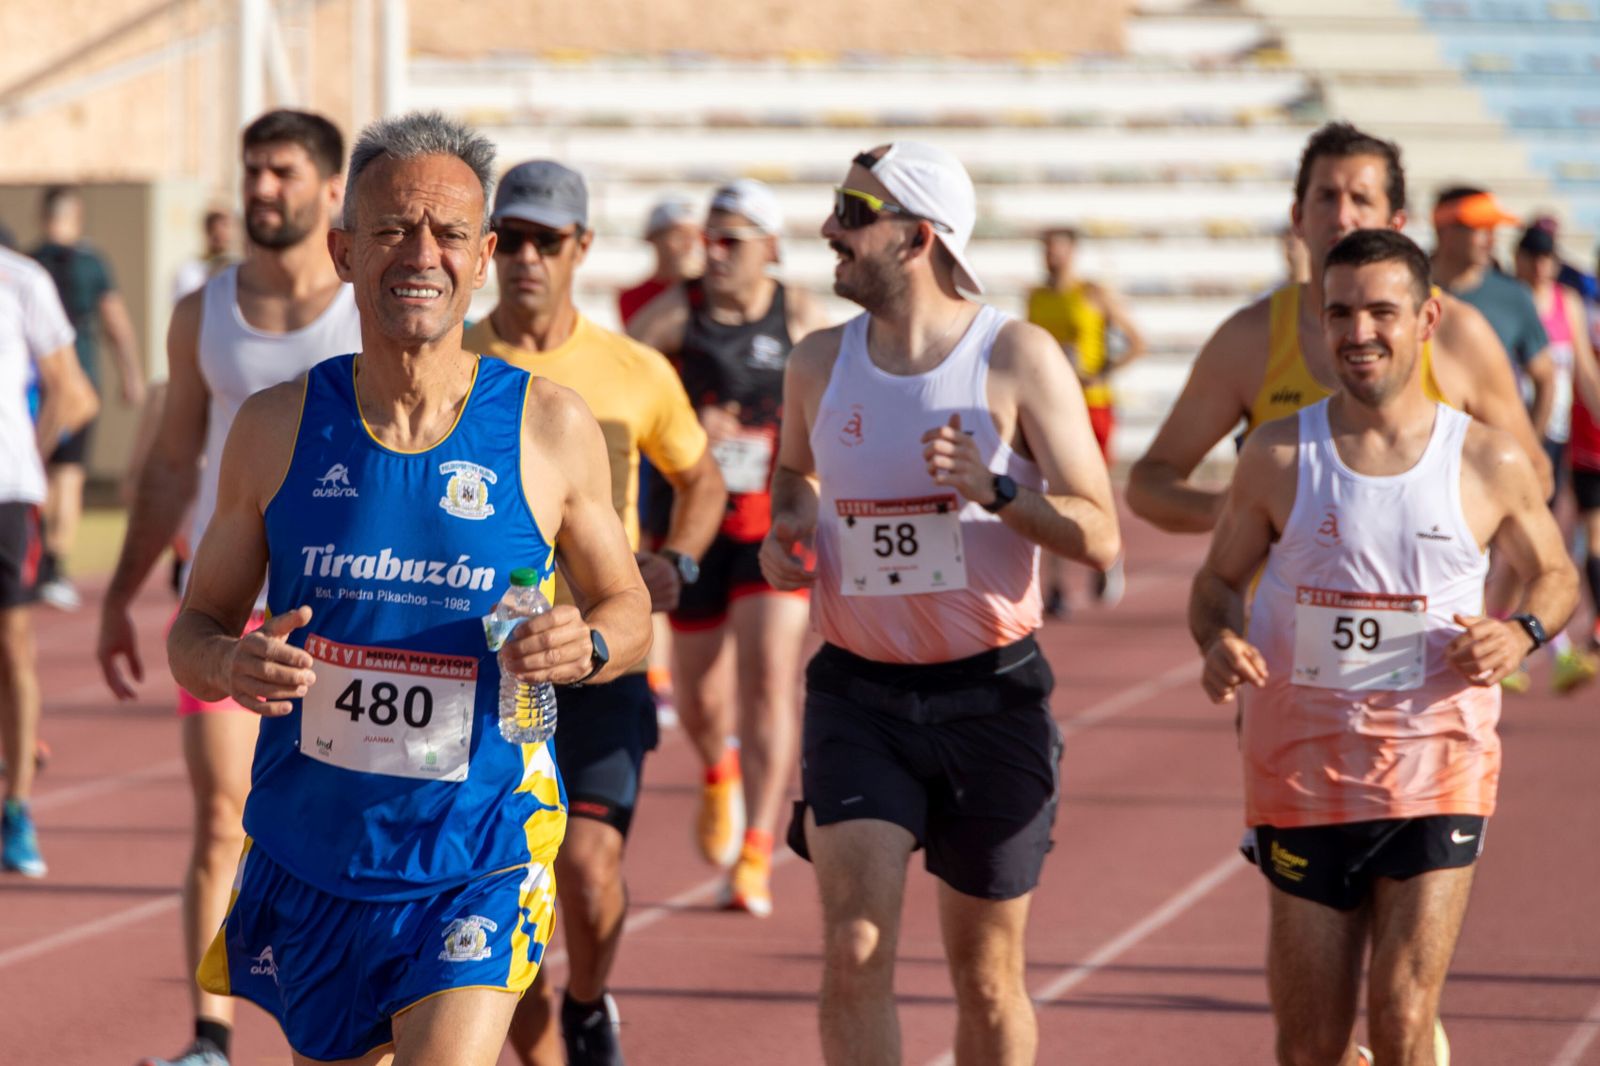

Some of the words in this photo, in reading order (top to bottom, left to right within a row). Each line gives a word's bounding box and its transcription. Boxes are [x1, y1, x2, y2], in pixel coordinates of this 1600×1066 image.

[873, 522, 919, 558] 58
[302, 543, 496, 592] Tirabuzón
[338, 588, 374, 601] Piedra
[377, 589, 428, 607] Pikachos
[1332, 616, 1381, 651] 59
[366, 650, 406, 661] MEDIA
[410, 662, 427, 673] DE
[335, 679, 433, 728] 480
[364, 735, 394, 744] JUANMA
